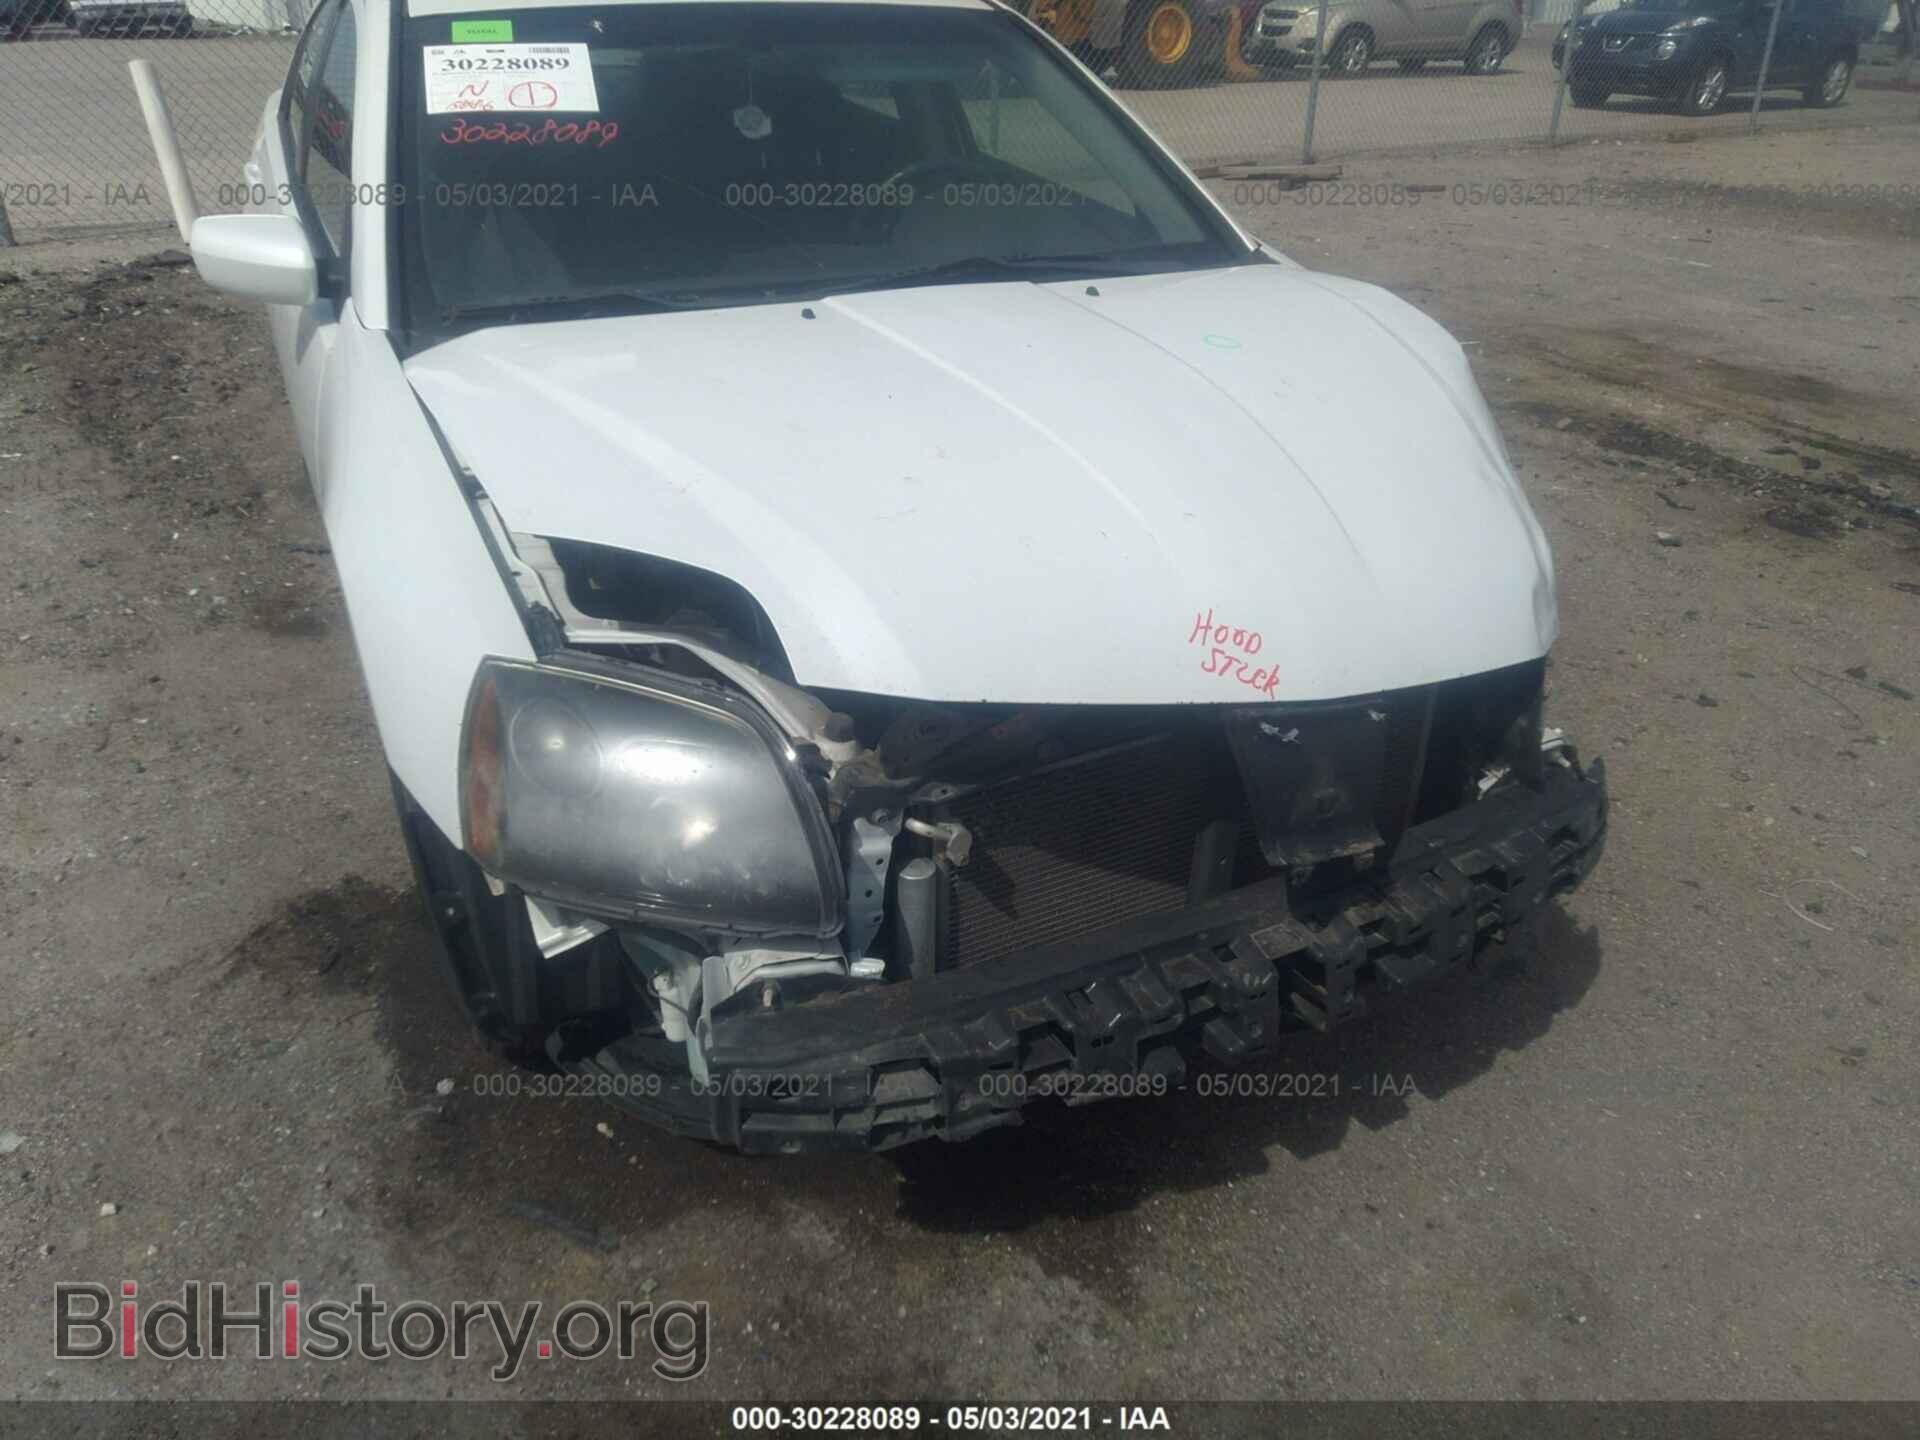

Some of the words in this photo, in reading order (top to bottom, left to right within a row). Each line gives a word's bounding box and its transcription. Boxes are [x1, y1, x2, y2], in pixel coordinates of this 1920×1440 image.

[441, 58, 570, 71] 30228089
[441, 118, 619, 147] 30228089
[1188, 608, 1262, 654] HOOD
